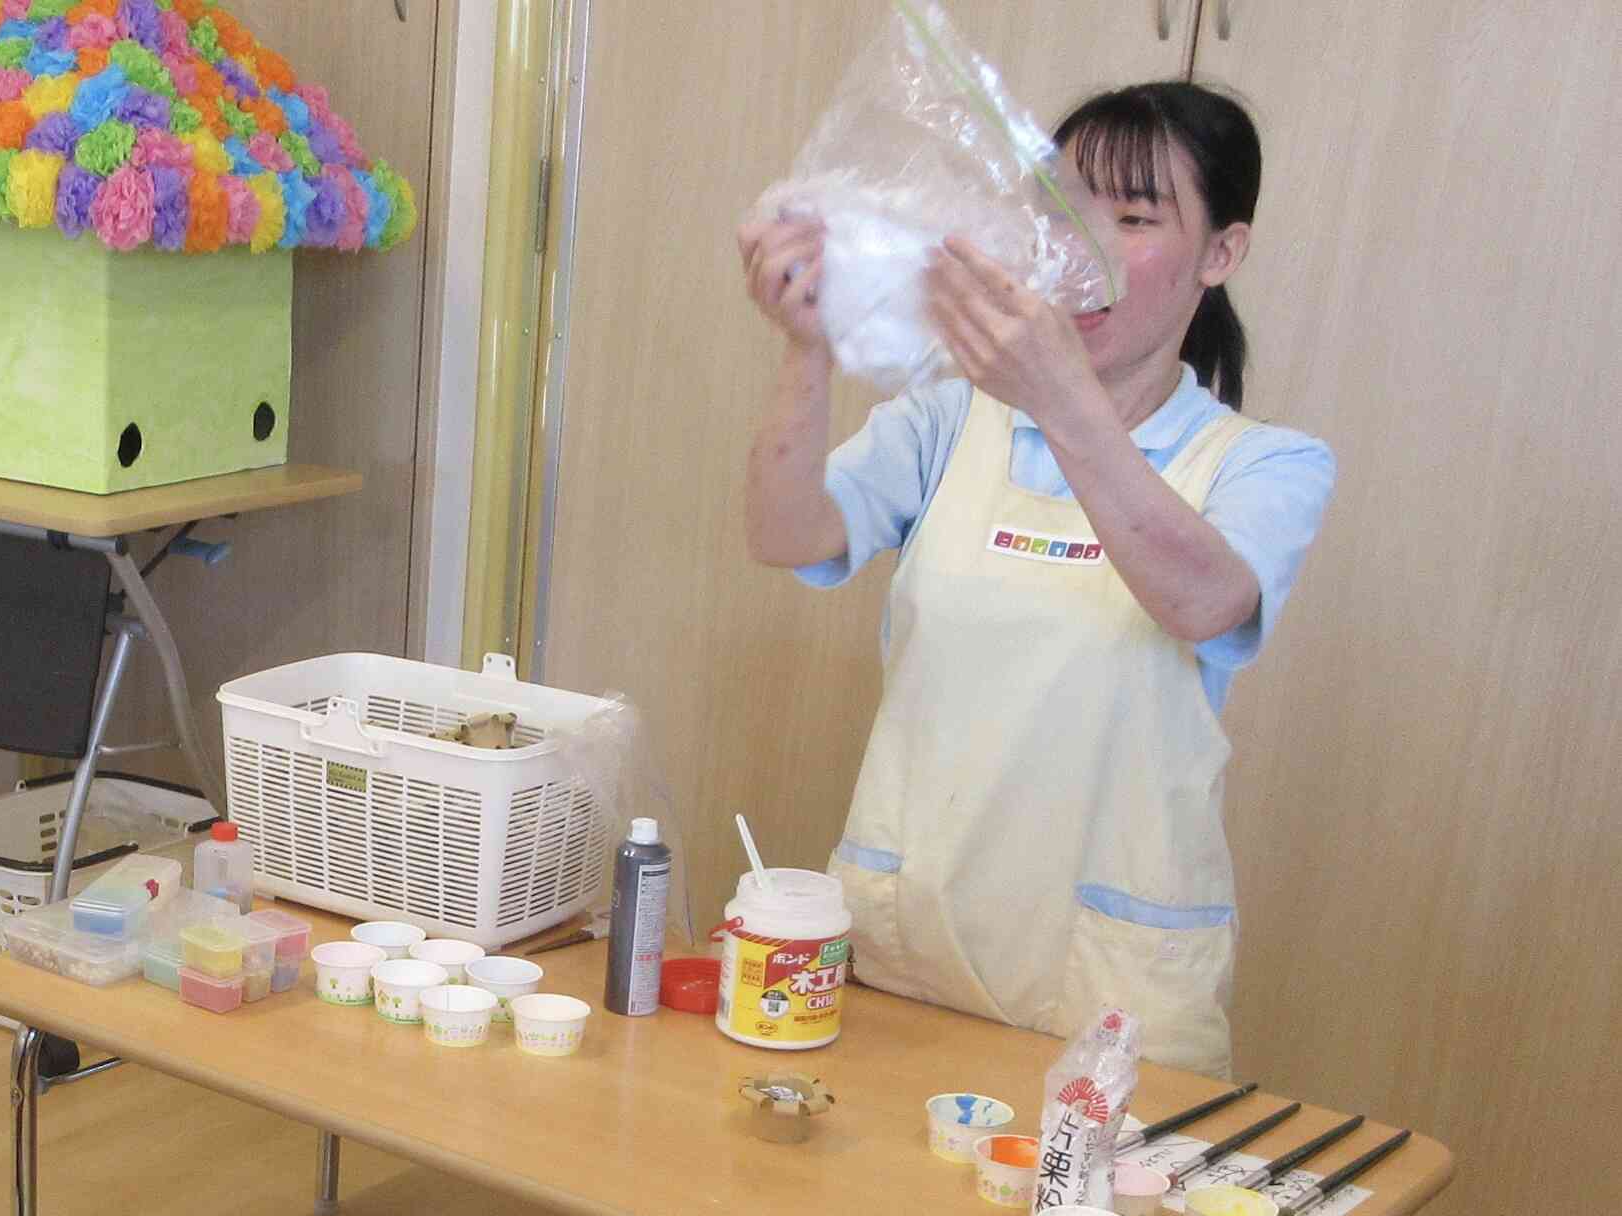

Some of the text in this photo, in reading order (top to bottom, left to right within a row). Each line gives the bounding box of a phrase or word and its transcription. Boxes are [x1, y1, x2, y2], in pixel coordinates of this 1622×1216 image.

[773, 953, 810, 965] ボンド
[1034, 1112, 1079, 1213] 片栗粉
